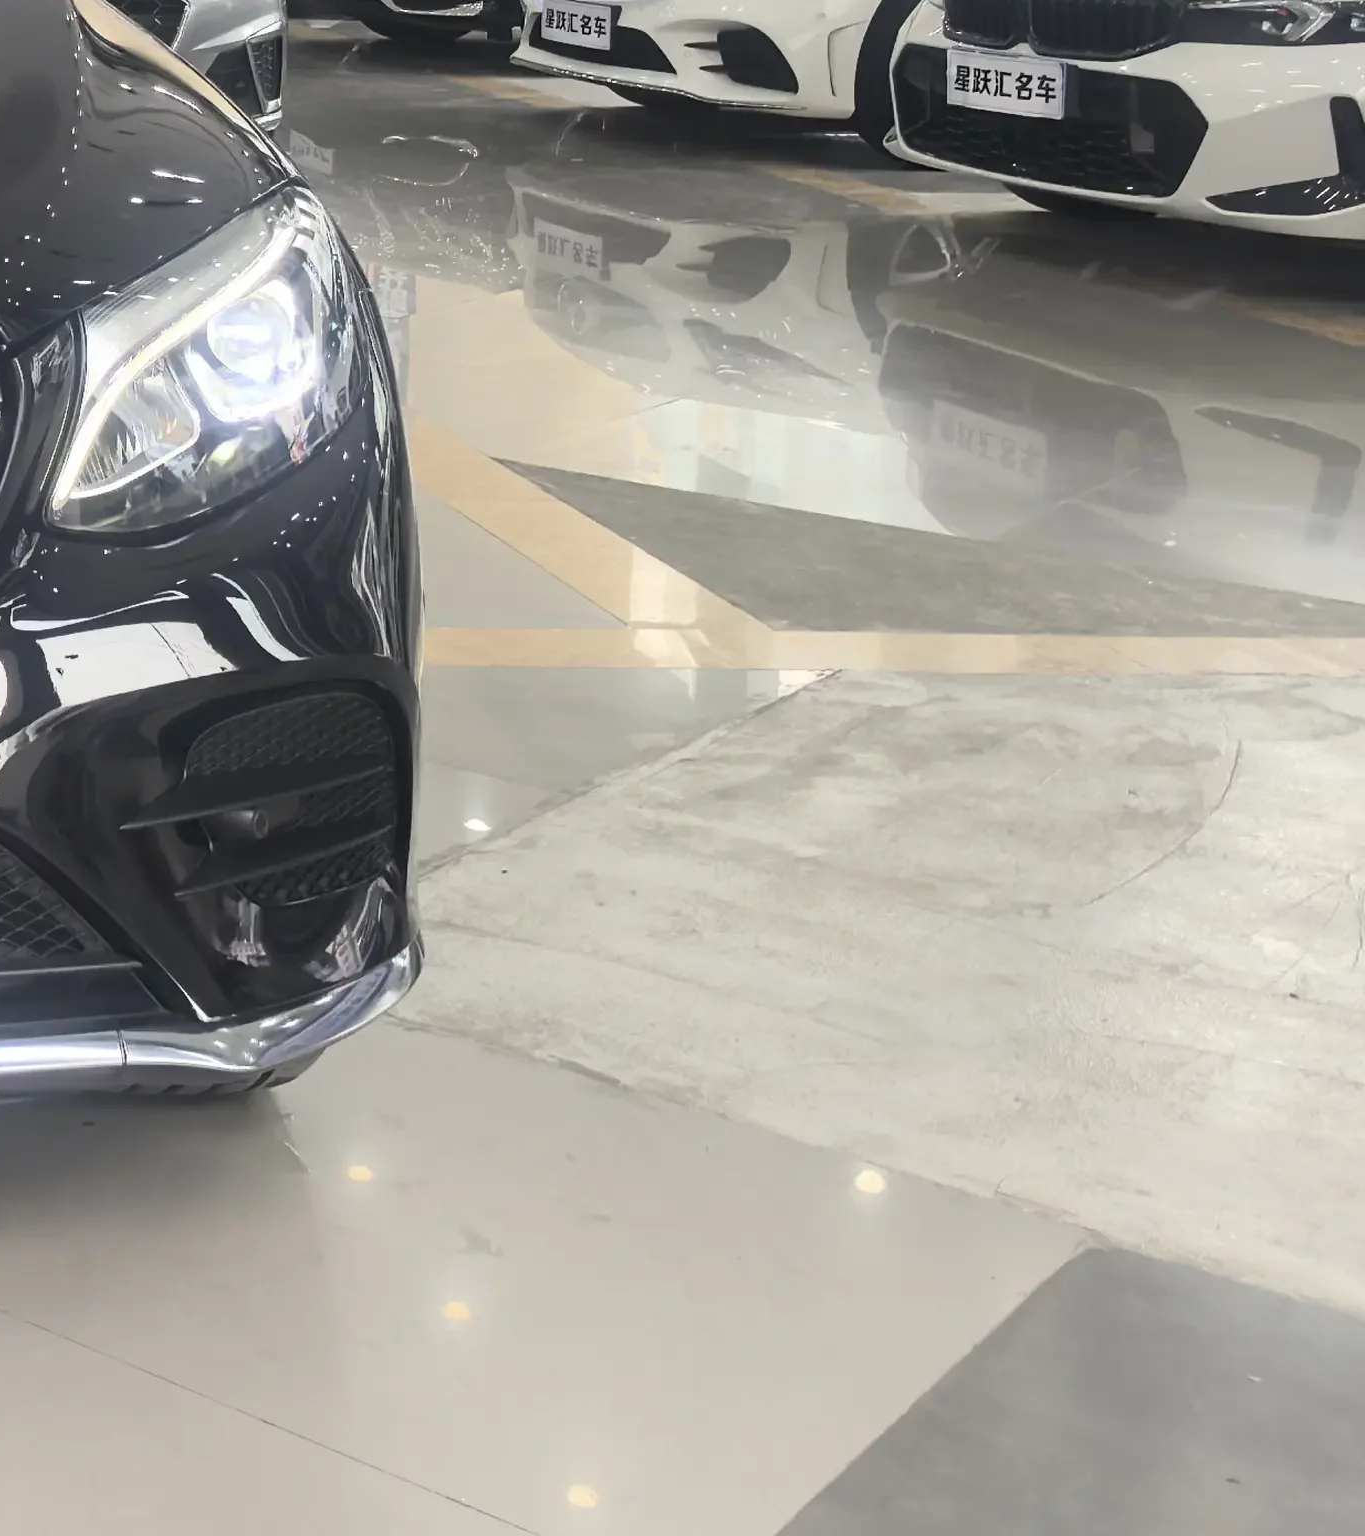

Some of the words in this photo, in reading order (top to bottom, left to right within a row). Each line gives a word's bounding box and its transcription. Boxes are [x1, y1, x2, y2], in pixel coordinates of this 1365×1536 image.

[545, 8, 607, 38] 星跃汇名车
[954, 65, 1057, 103] 星跃汇名车
